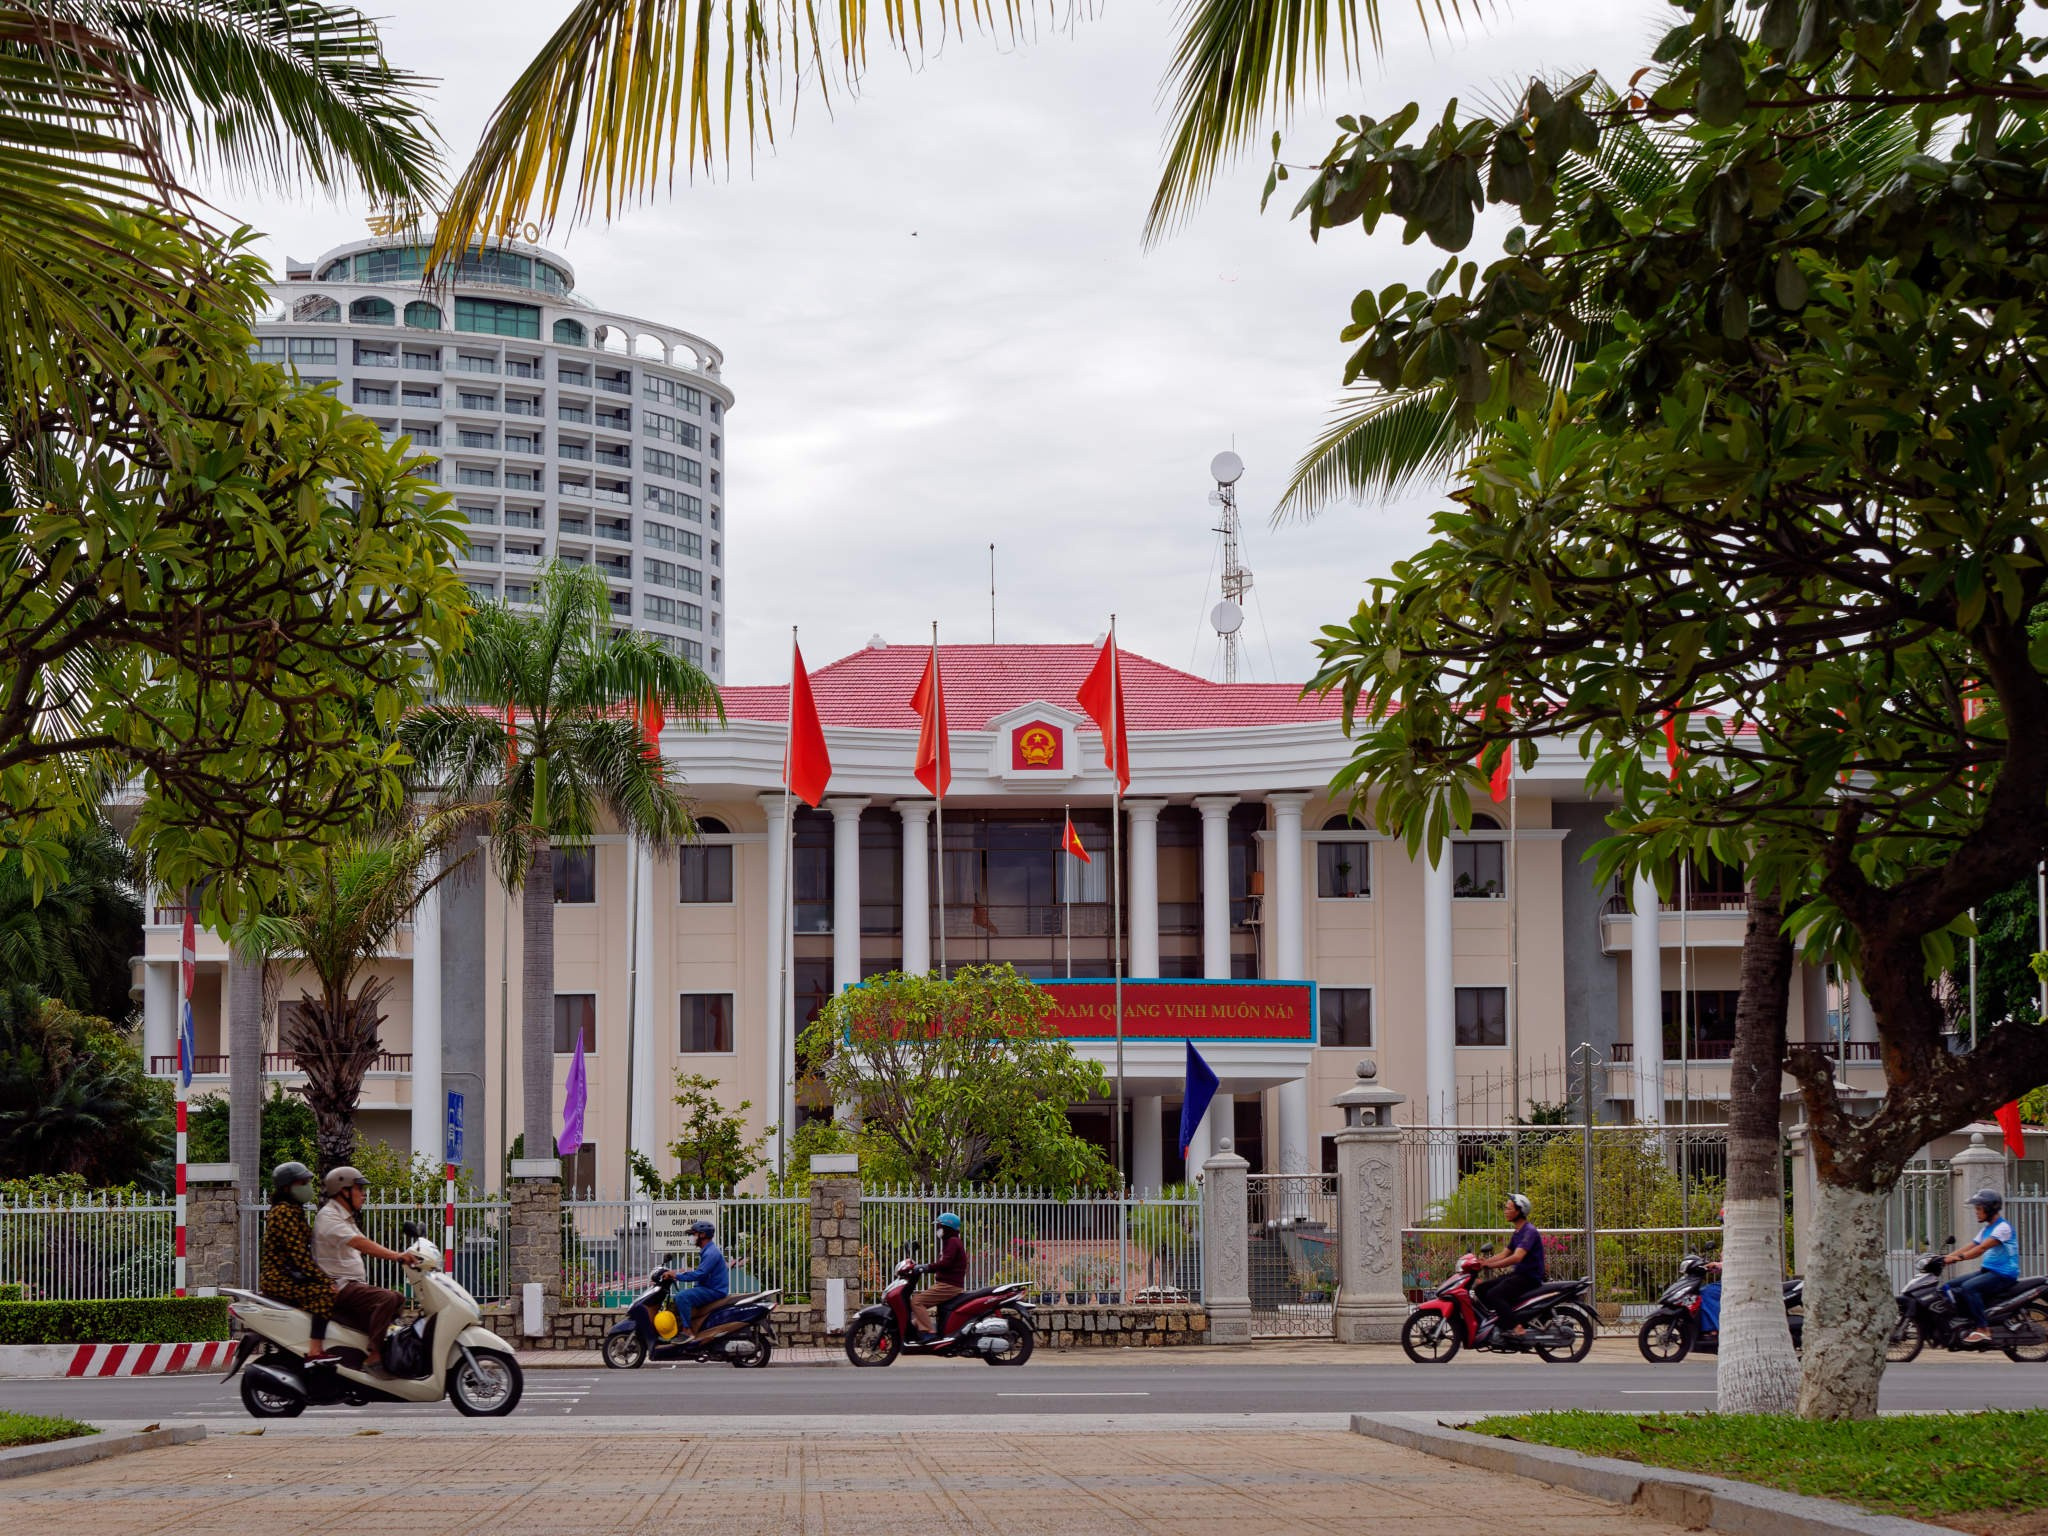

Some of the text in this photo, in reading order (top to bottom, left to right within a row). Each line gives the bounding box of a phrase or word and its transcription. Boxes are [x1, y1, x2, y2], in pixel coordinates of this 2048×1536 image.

[1053, 1004, 1095, 1018] NAM
[1164, 1003, 1208, 1018] VINH
[1211, 1001, 1260, 1018] MUÔN
[668, 1208, 678, 1216] GHI
[689, 1208, 699, 1216] GHI
